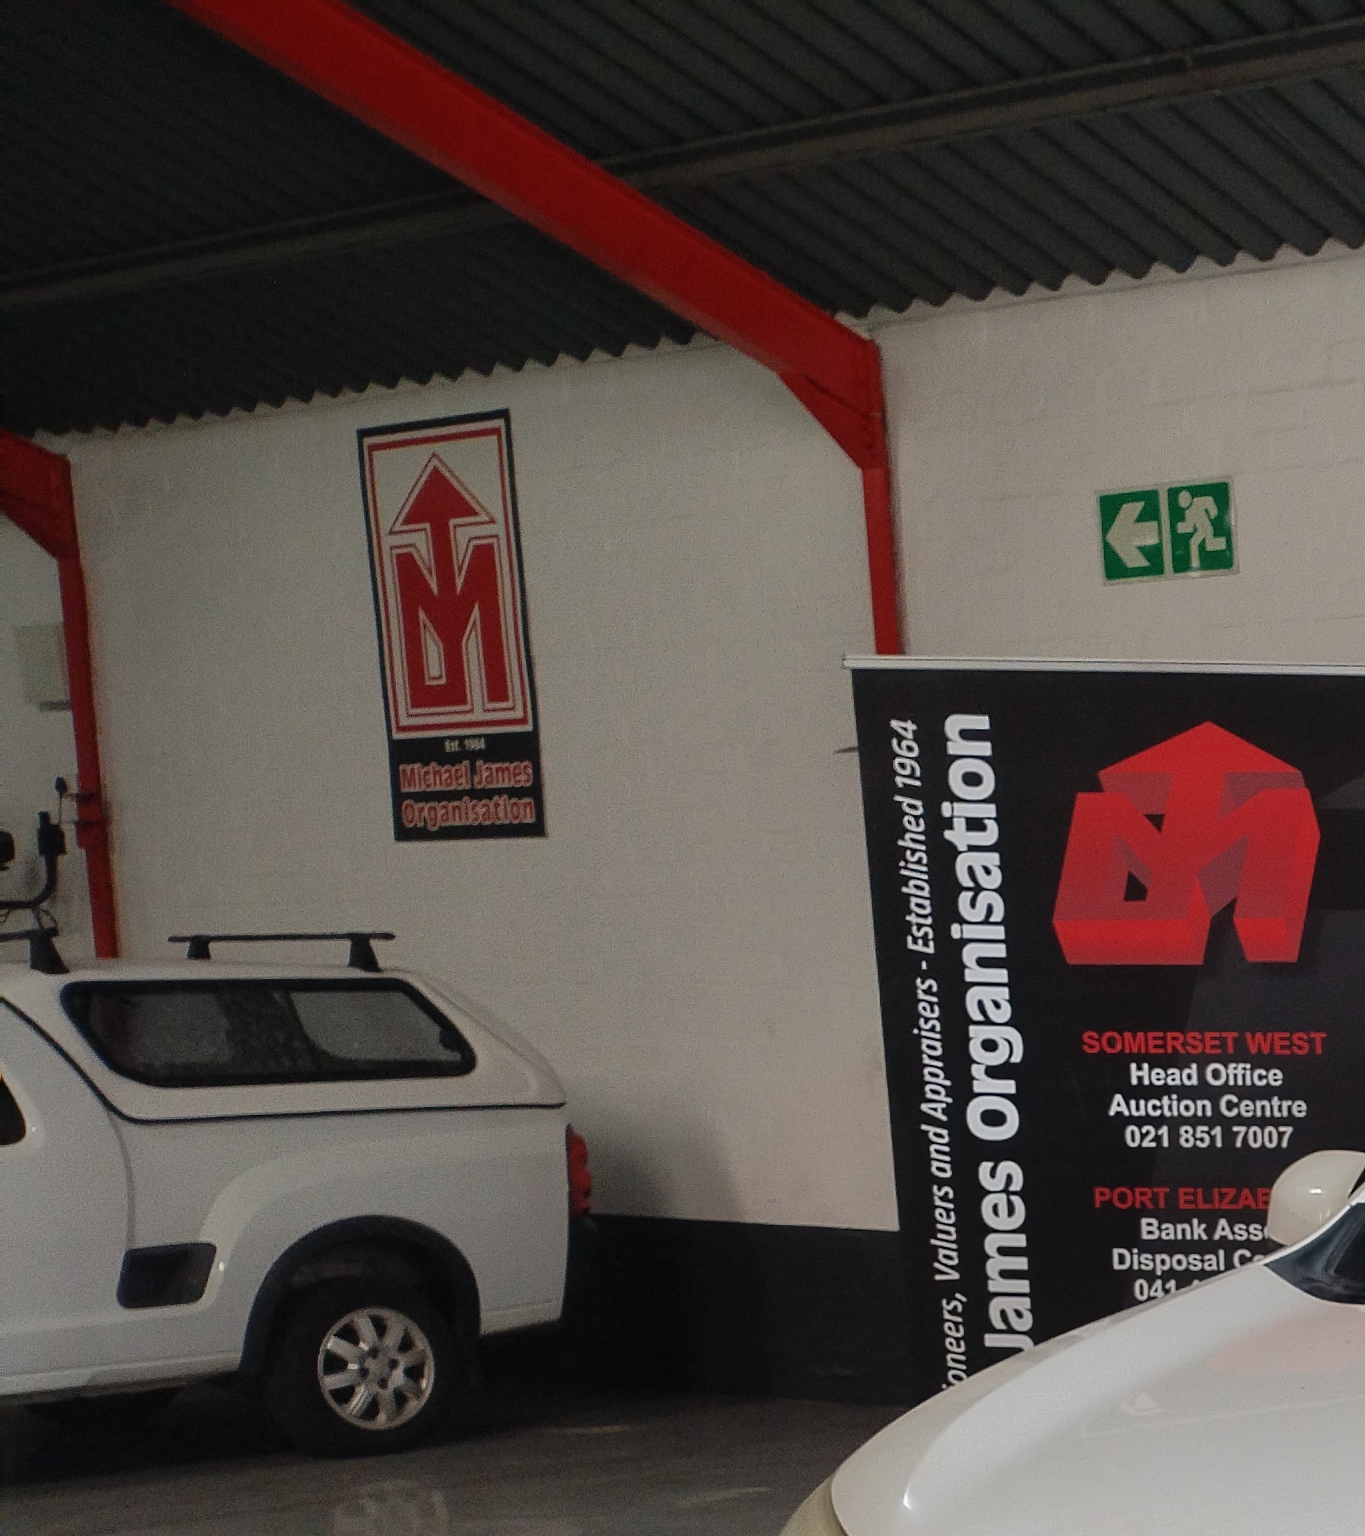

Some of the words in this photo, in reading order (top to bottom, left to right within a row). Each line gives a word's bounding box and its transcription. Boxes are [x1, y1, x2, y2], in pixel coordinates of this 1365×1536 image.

[890, 718, 922, 788] 1964
[399, 761, 471, 792] Michael
[474, 760, 533, 789] James
[402, 794, 536, 831] Organisation
[893, 794, 935, 954] Established
[913, 976, 953, 1122] Appraisers
[1082, 1031, 1239, 1055] SOMERSET
[1245, 1031, 1328, 1056] WEST
[1129, 1062, 1199, 1086] Head
[1205, 1062, 1284, 1087] Office
[1108, 1093, 1213, 1118] Auction
[1219, 1094, 1308, 1118] Centre
[920, 1124, 953, 1179] and
[1124, 1125, 1170, 1148] 021
[1178, 1125, 1223, 1148] 851
[1231, 1125, 1294, 1149] 7007
[1093, 1187, 1170, 1210] PORT
[930, 1184, 961, 1282] Valuers
[1140, 1218, 1209, 1241] Bank
[978, 1160, 1035, 1351] James
[1112, 1248, 1226, 1275] Disposal
